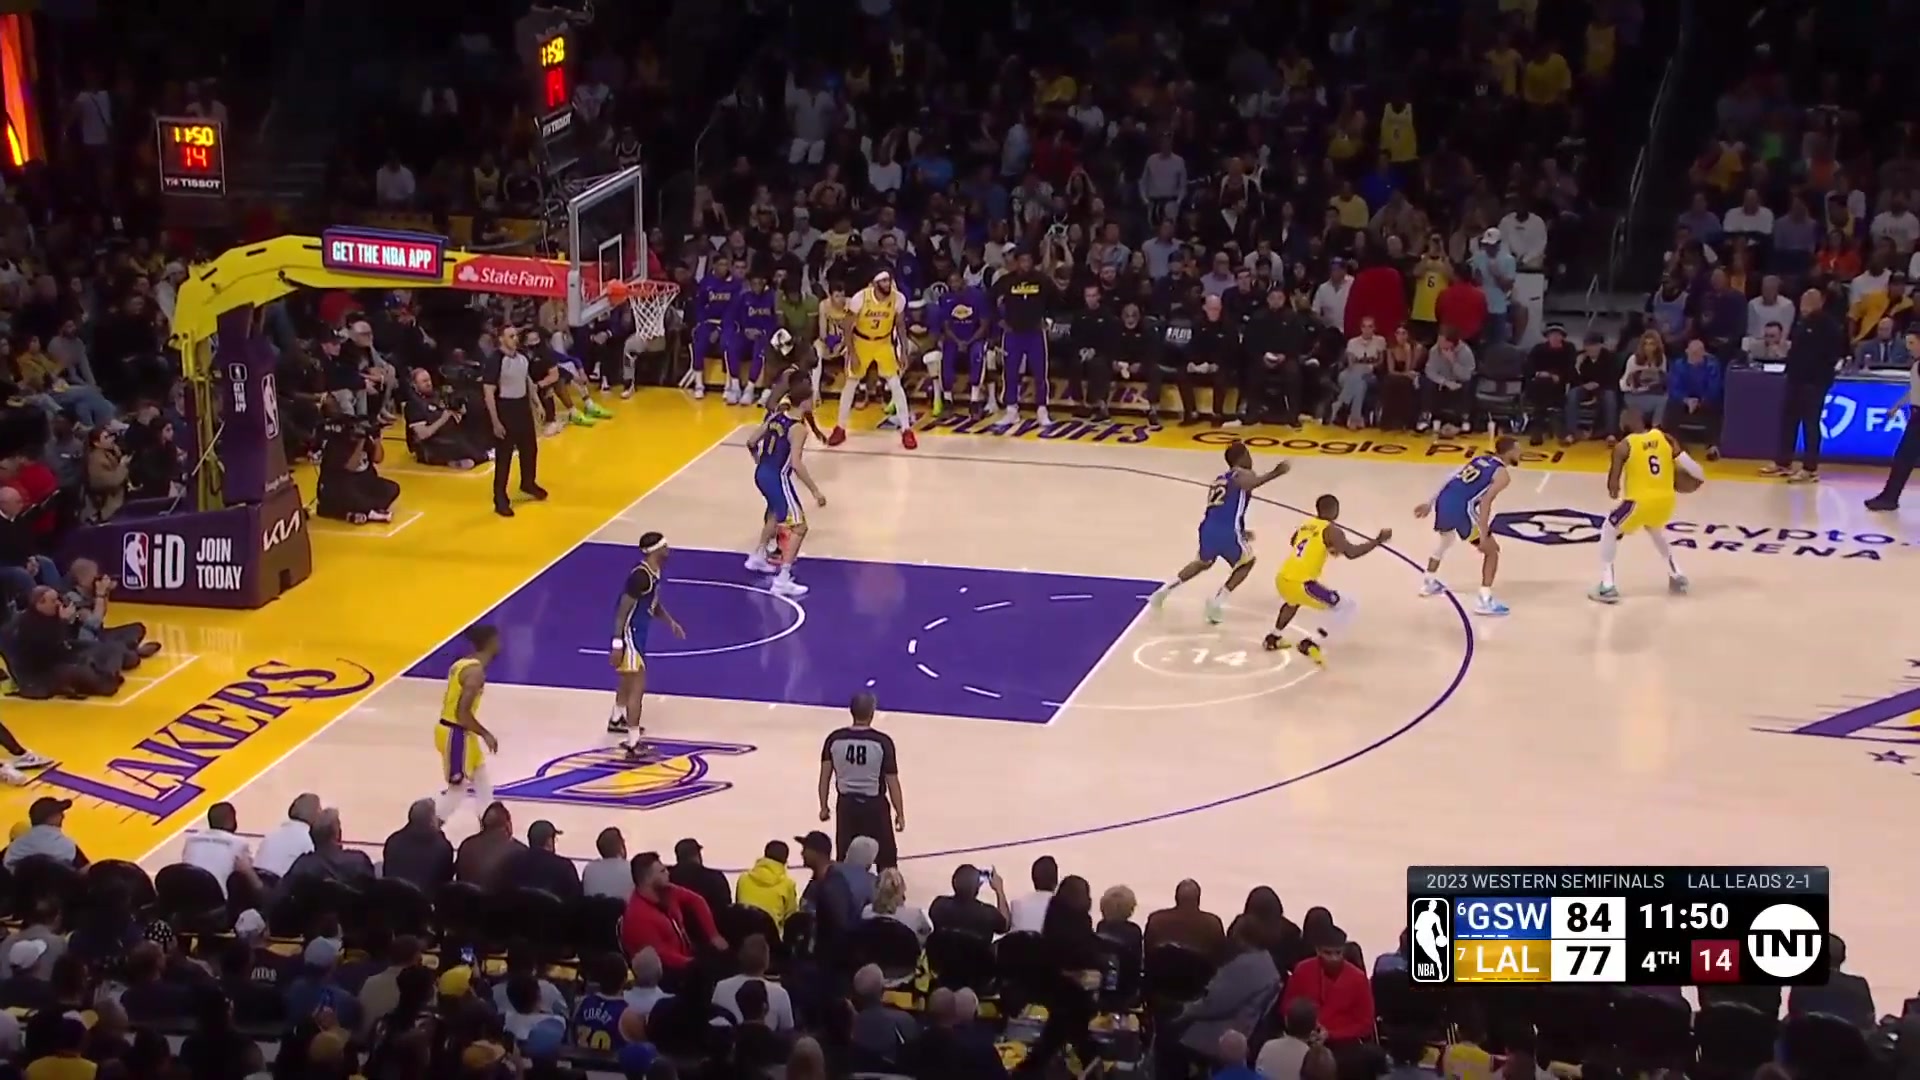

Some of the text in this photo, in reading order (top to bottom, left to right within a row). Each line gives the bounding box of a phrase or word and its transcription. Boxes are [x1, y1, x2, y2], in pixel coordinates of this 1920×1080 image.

[186, 147, 207, 168] 14
[180, 178, 221, 189] TISSOT
[332, 240, 432, 270] GET THE NBA APP
[870, 319, 880, 330] 3
[1192, 430, 1408, 456] Google
[1648, 455, 1660, 475] 6
[196, 537, 232, 563] JOIN
[1296, 538, 1309, 558] 4
[1669, 537, 1882, 562] ARENA
[152, 533, 186, 589] iD
[196, 565, 242, 590] TODAY
[38, 658, 375, 826] LAKERS
[845, 744, 867, 765] 48
[583, 1007, 612, 1024] CURRY
